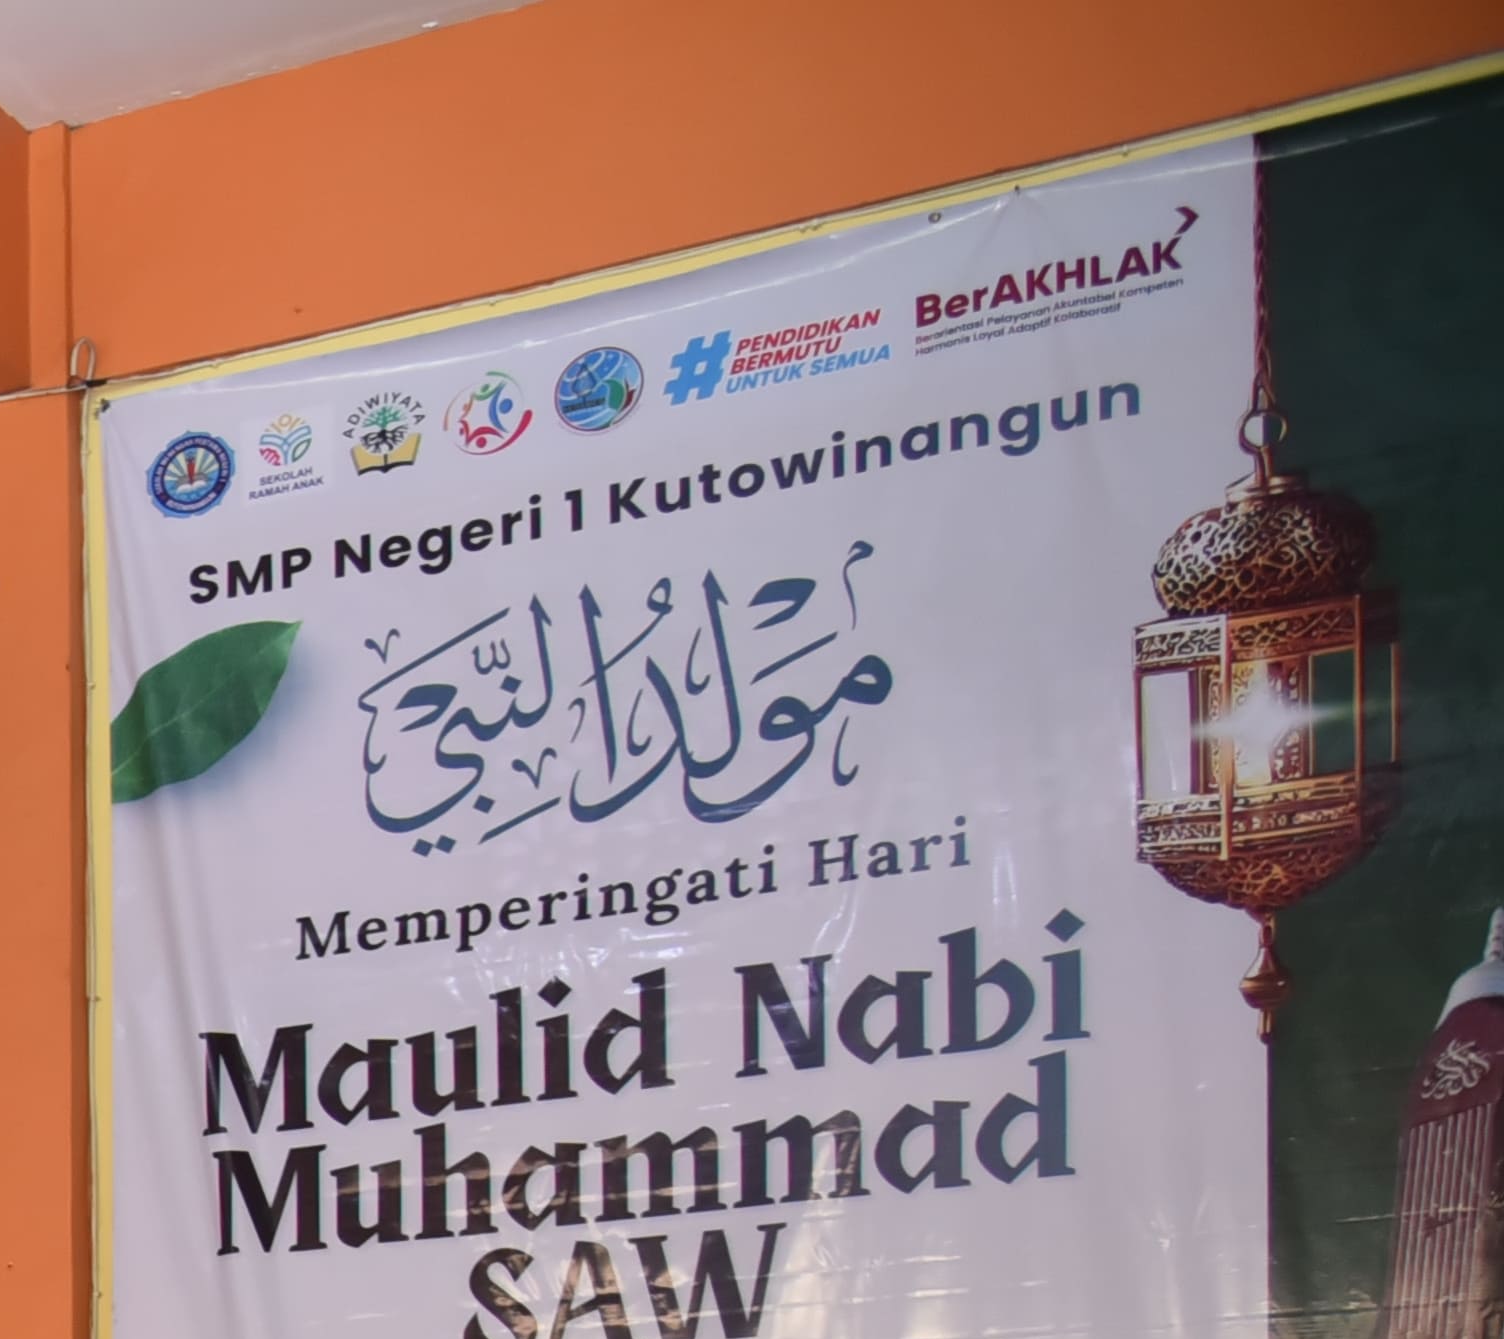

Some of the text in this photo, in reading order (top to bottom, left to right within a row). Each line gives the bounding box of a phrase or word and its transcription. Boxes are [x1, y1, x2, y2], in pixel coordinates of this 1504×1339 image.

[915, 236, 1183, 328] BerAKHLAK
[729, 337, 842, 376] BERMUTU
[736, 308, 881, 356] PENDIDIKAN
[726, 344, 891, 394] UNTUK SEMUA
[342, 391, 426, 439] ADIWIYATA
[190, 380, 1140, 605] SMP Negeri 1 Kutowinangun
[259, 467, 313, 486] SEKOLAH
[292, 475, 324, 490] ANAK
[294, 815, 972, 961] Memperingati Hari
[198, 907, 1092, 1137] Maulid Nabi
[212, 1052, 1076, 1257] Muhammad
